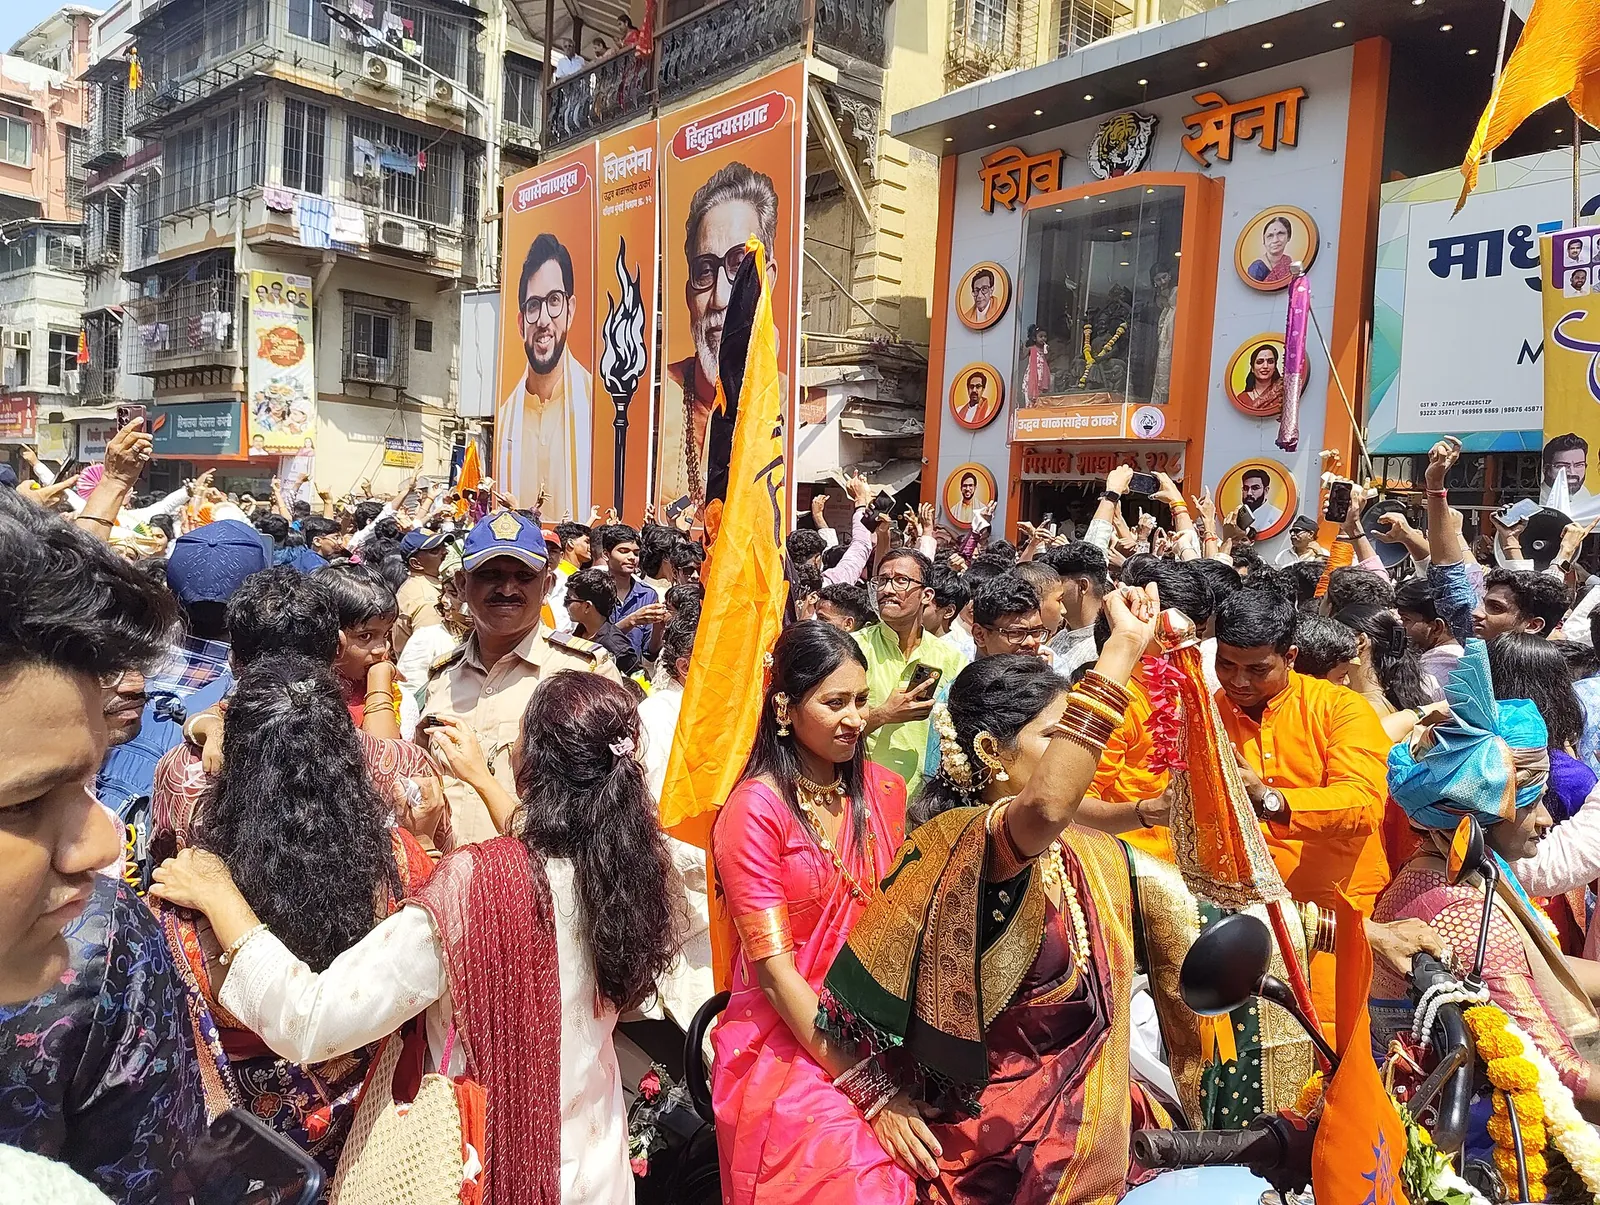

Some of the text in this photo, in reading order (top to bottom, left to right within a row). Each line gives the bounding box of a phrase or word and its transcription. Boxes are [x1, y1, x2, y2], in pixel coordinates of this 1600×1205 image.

[603, 145, 653, 184] शिवसेना
[978, 86, 1309, 214] शिव सेना
[518, 168, 578, 209] युवासेनाप्रमुख
[1018, 411, 1119, 432] उद्धव बाळासाहेब ठाकरे
[1524, 404, 1543, 412] 45871
